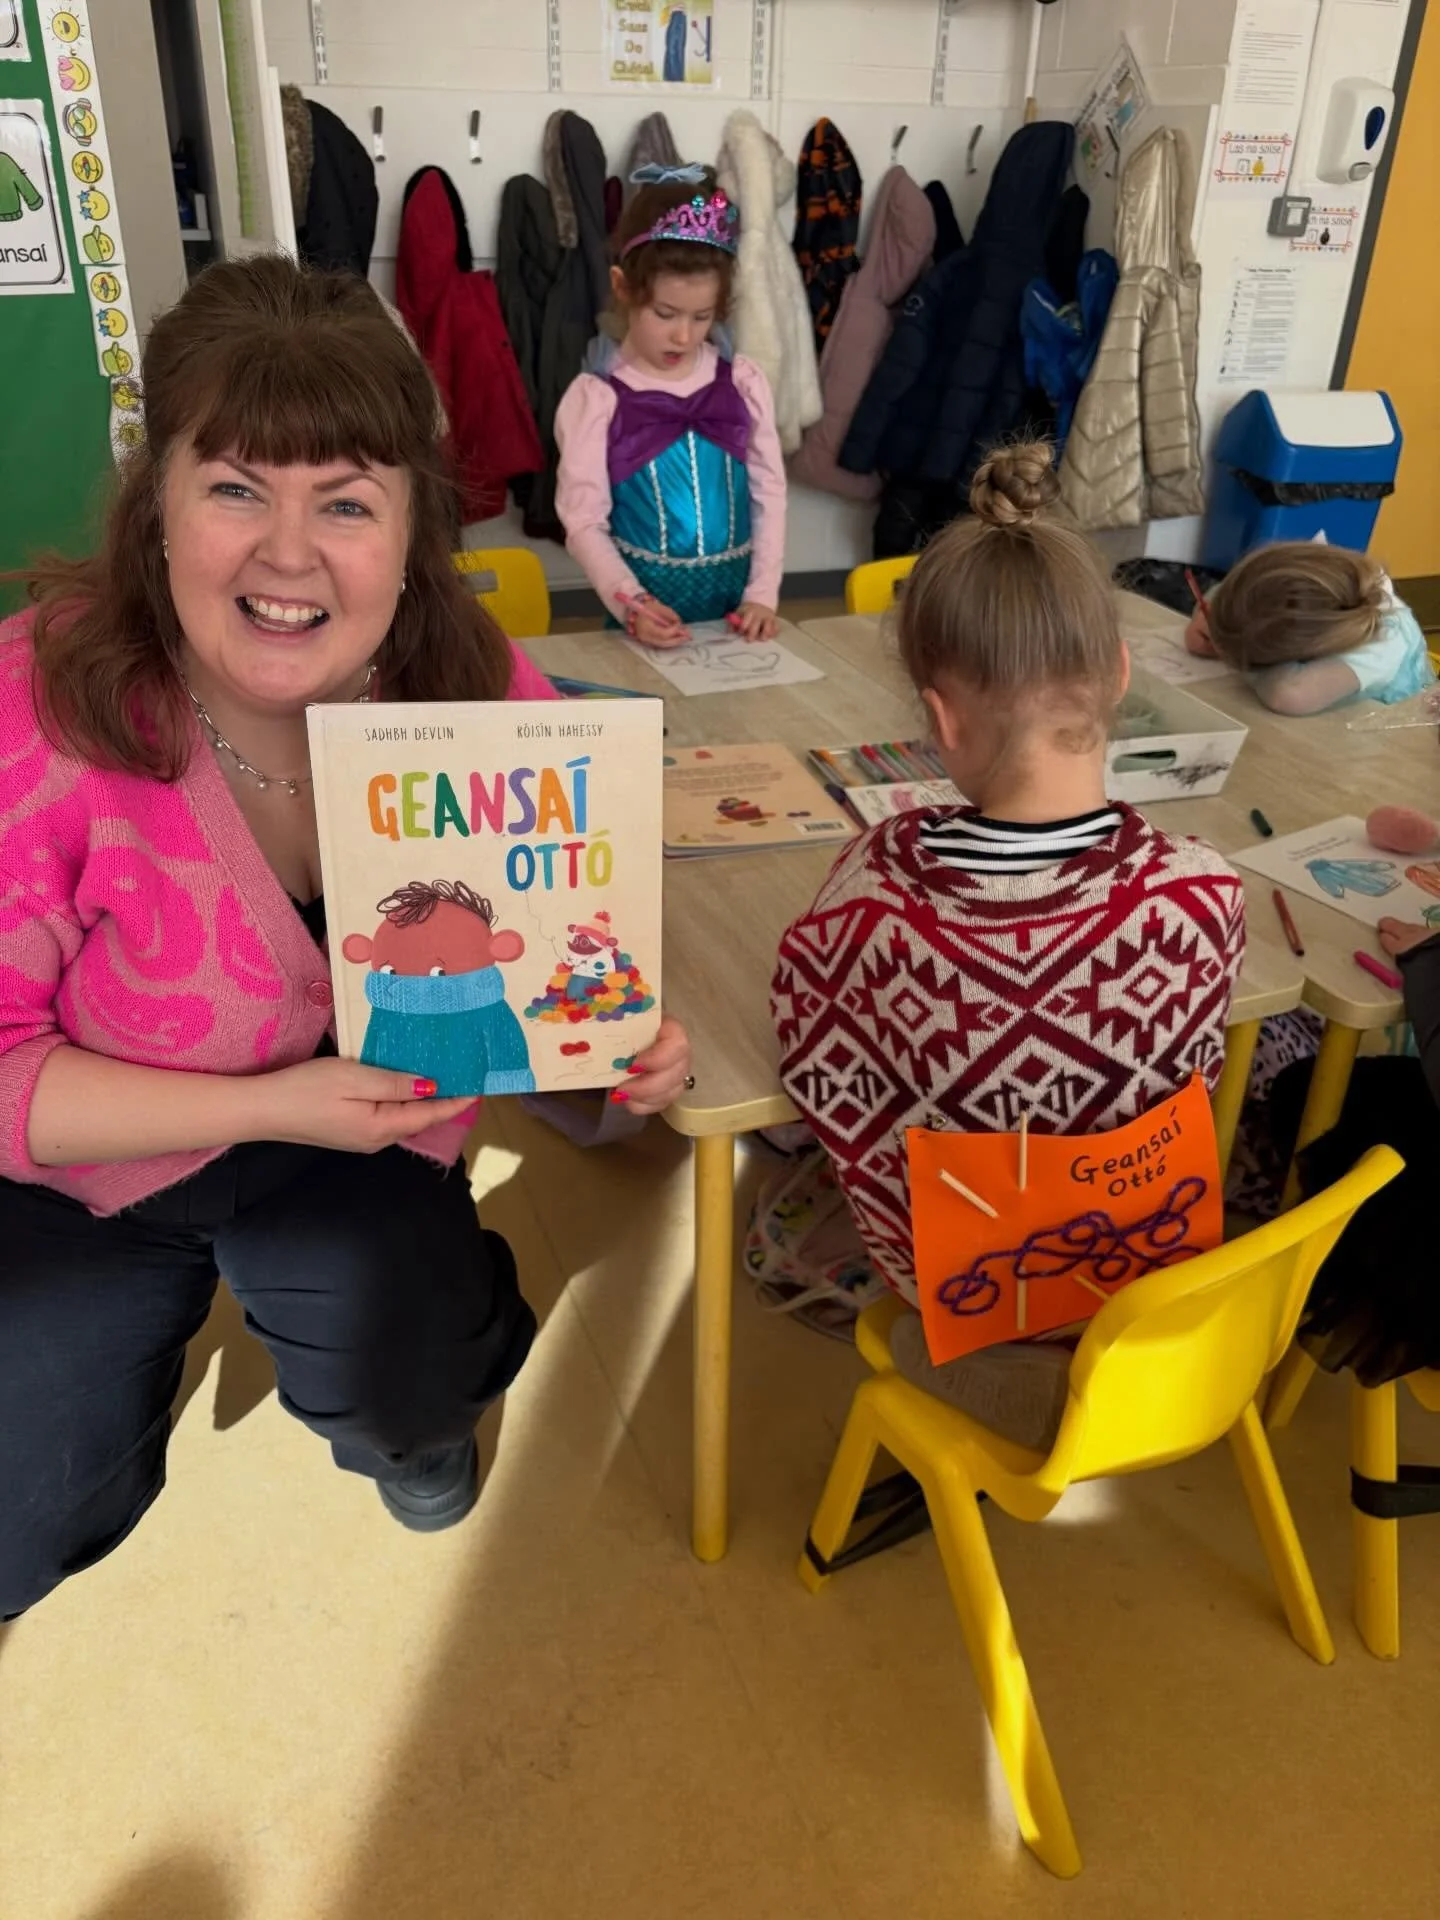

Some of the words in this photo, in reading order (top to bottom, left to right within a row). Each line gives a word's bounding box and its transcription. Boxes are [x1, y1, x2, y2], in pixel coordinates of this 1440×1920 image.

[364, 727, 408, 742] SADHBH
[414, 727, 455, 741] DEVLIN
[558, 723, 604, 738] HAHESSY
[367, 755, 592, 842] GEANSAÍ
[506, 828, 613, 892] OTTÓ
[1070, 1105, 1182, 1185] Geansaí
[1107, 1153, 1167, 1197] Ottó
